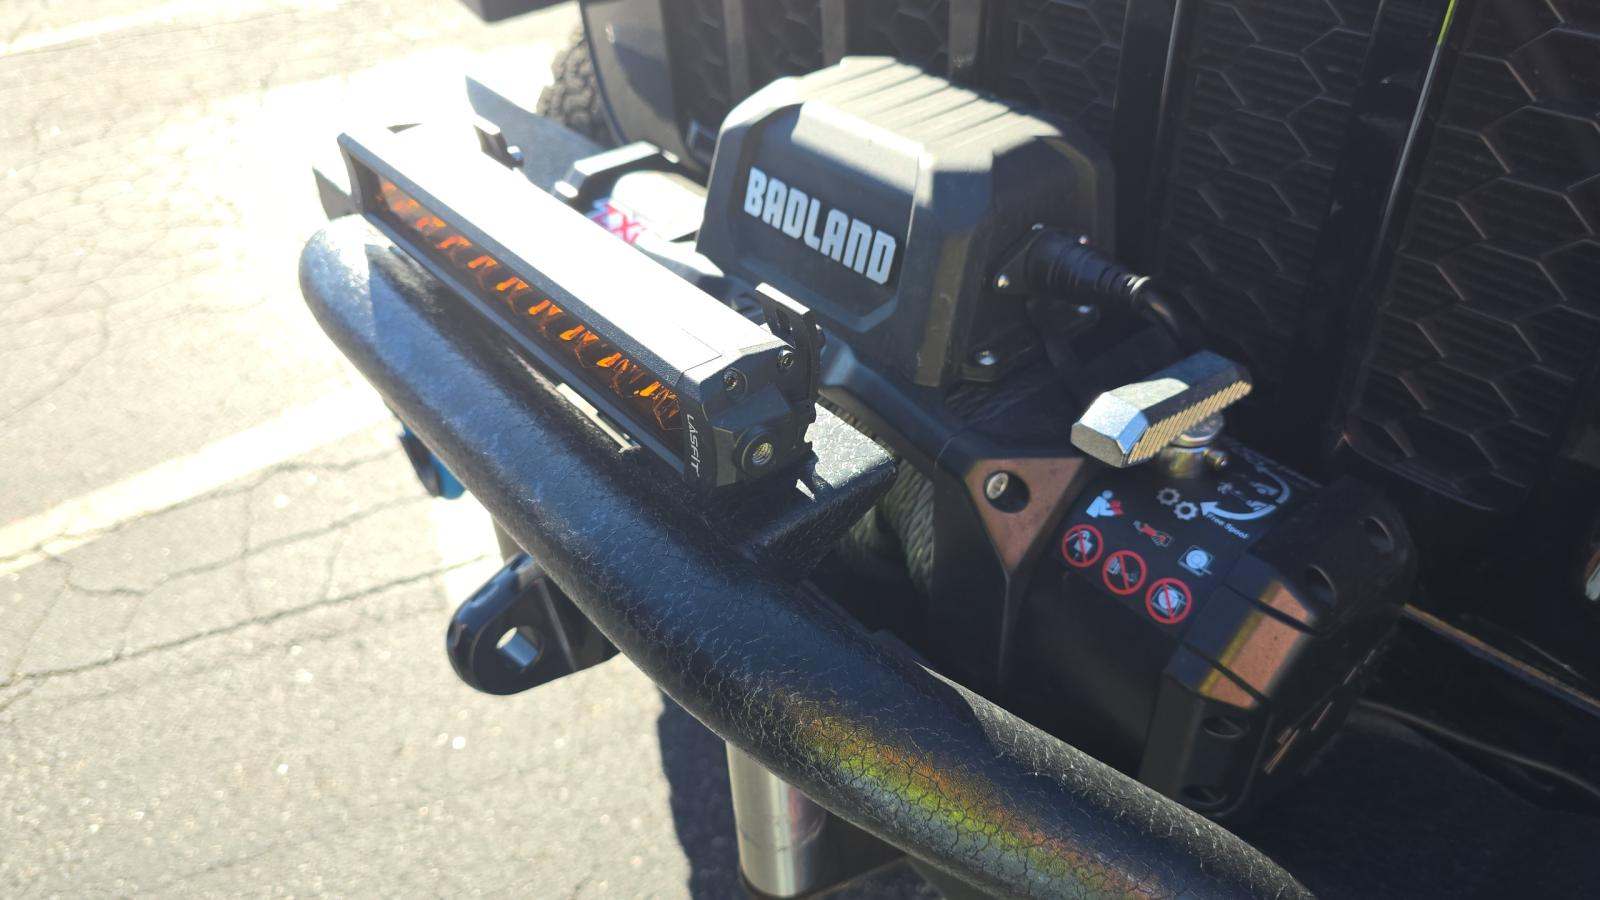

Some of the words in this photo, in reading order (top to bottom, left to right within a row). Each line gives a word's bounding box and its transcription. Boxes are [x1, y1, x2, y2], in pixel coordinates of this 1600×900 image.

[744, 166, 896, 285] BADLAND
[686, 413, 701, 478] LASFIT
[1206, 511, 1224, 526] Free
